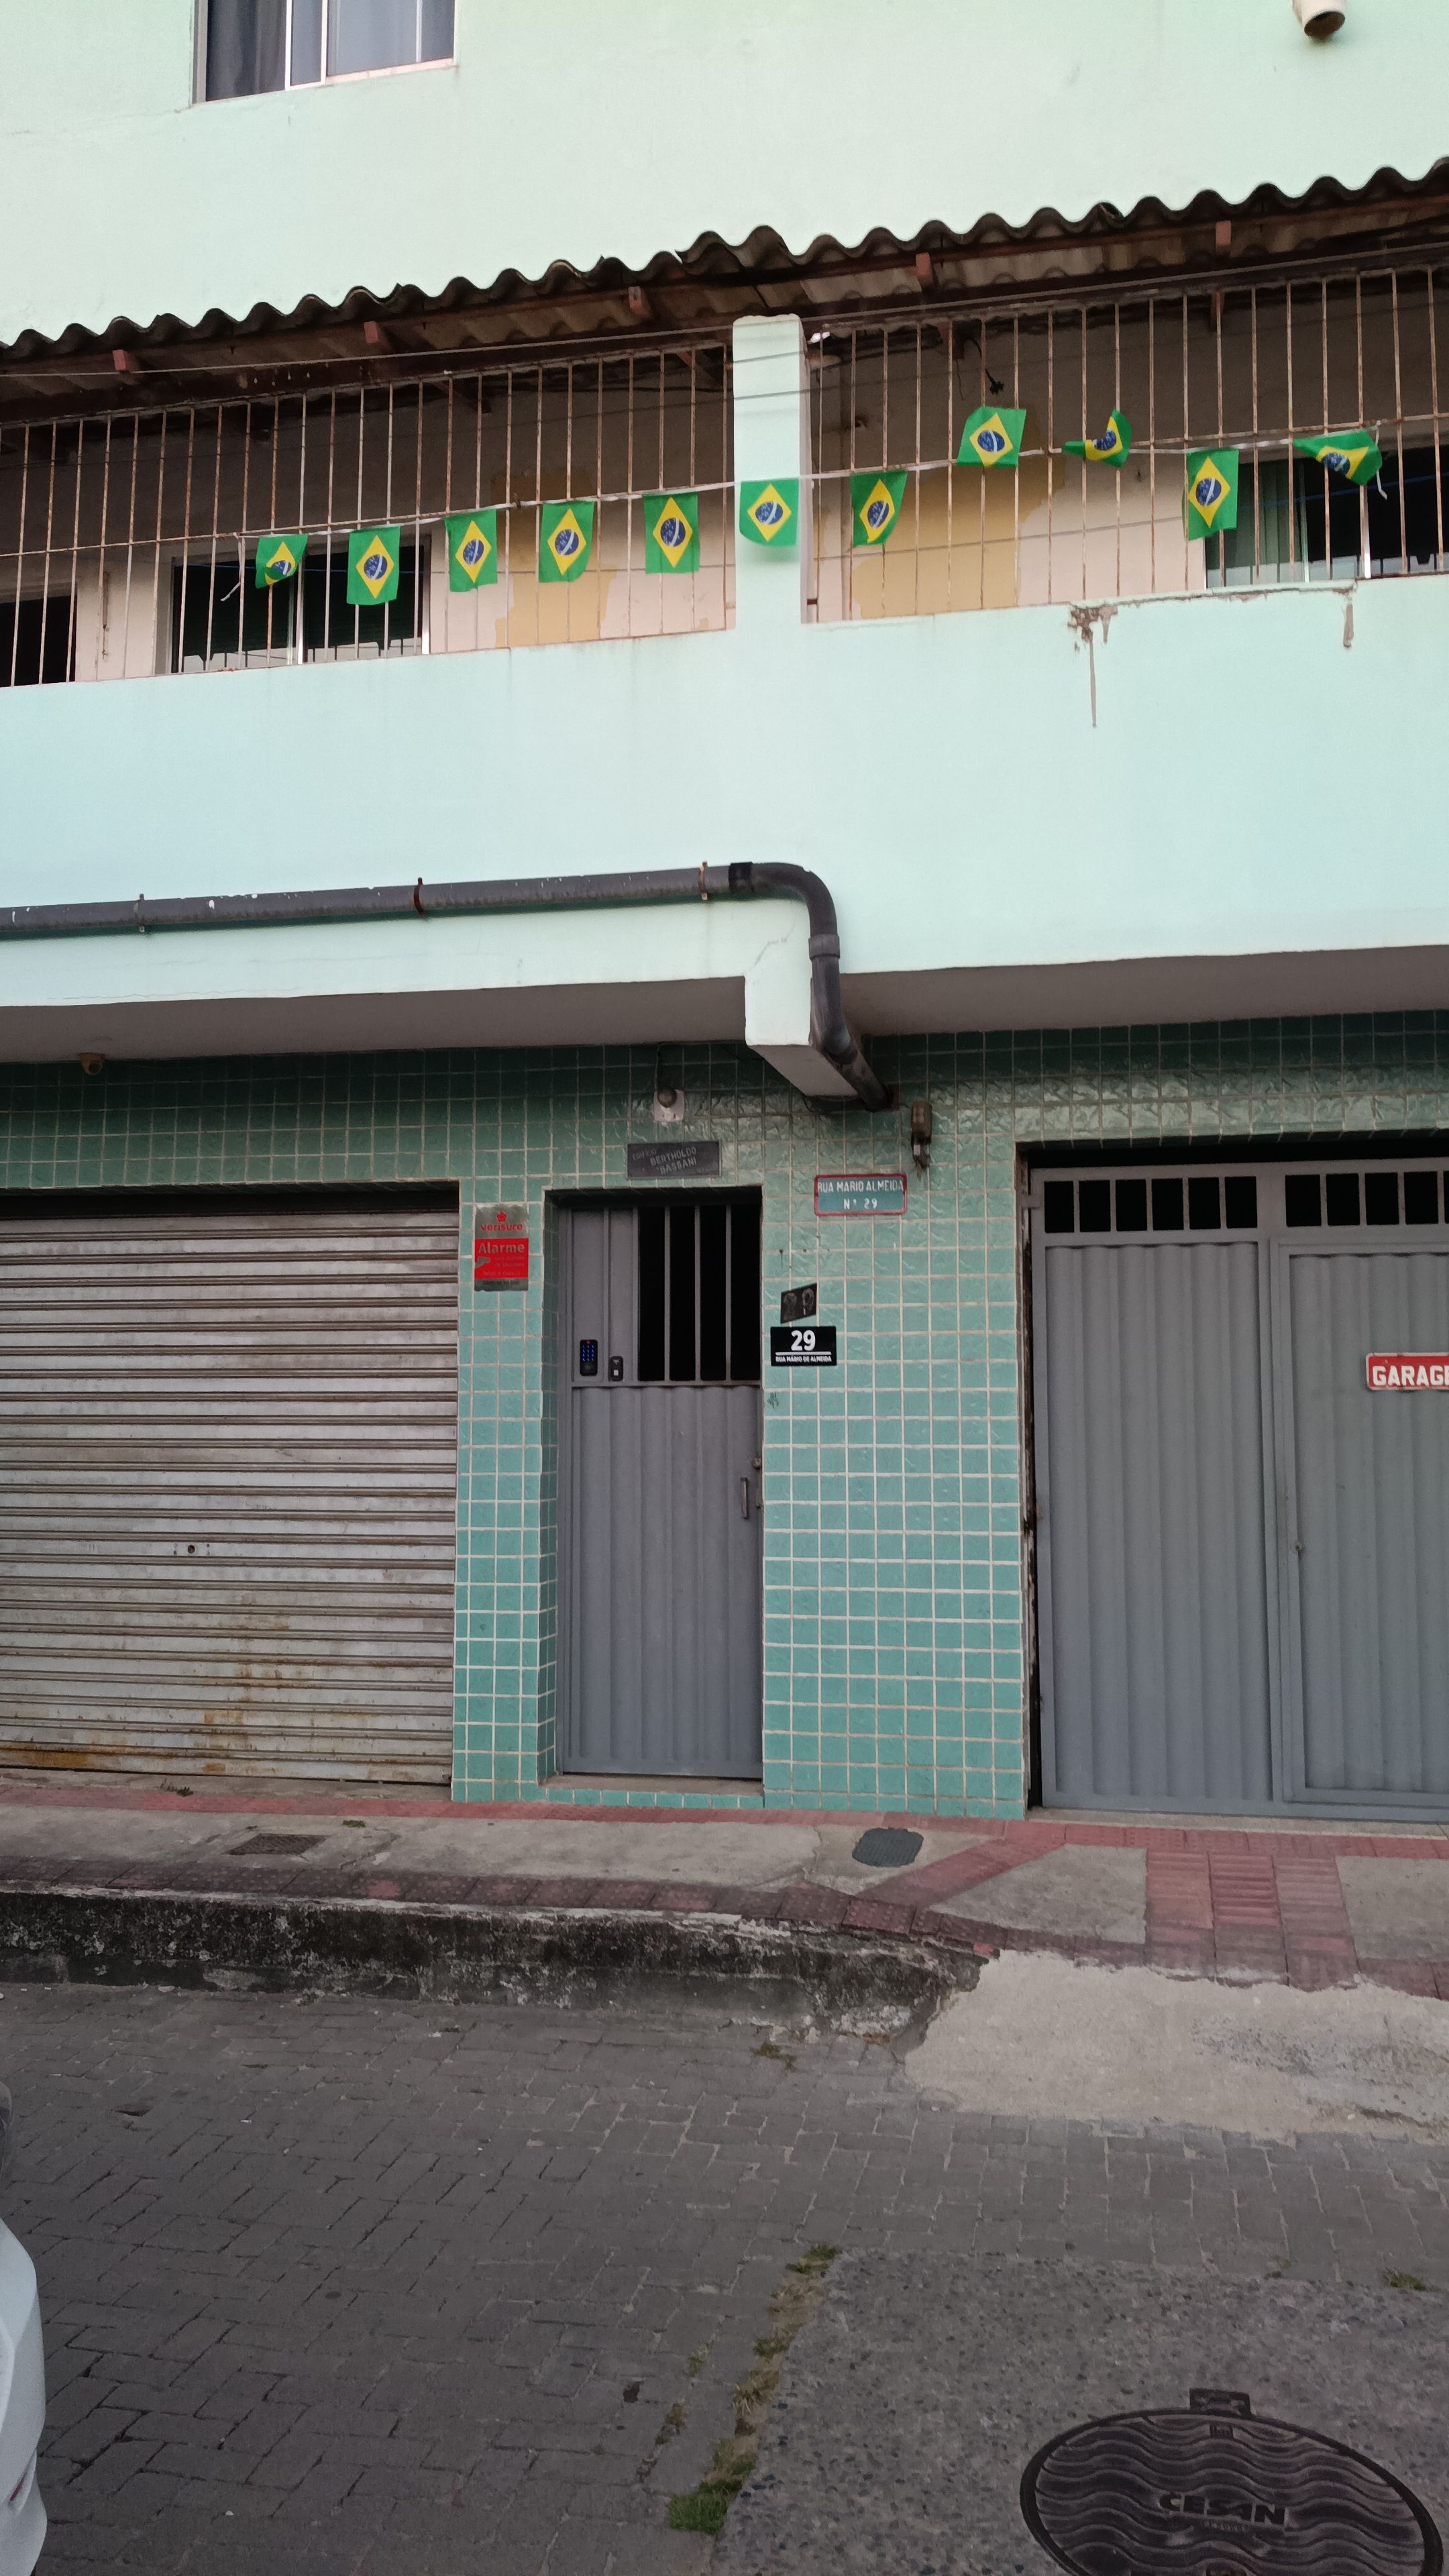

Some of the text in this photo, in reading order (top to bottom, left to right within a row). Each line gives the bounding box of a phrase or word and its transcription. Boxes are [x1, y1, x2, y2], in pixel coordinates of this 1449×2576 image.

[649, 1146, 697, 1166] BERTHOLDO
[817, 1179, 904, 1193] RUA MARIO ALMEIDA
[863, 1197, 877, 1210] 29
[480, 1223, 524, 1232] verisure
[478, 1242, 525, 1254] Alarme
[790, 1330, 816, 1352] 29
